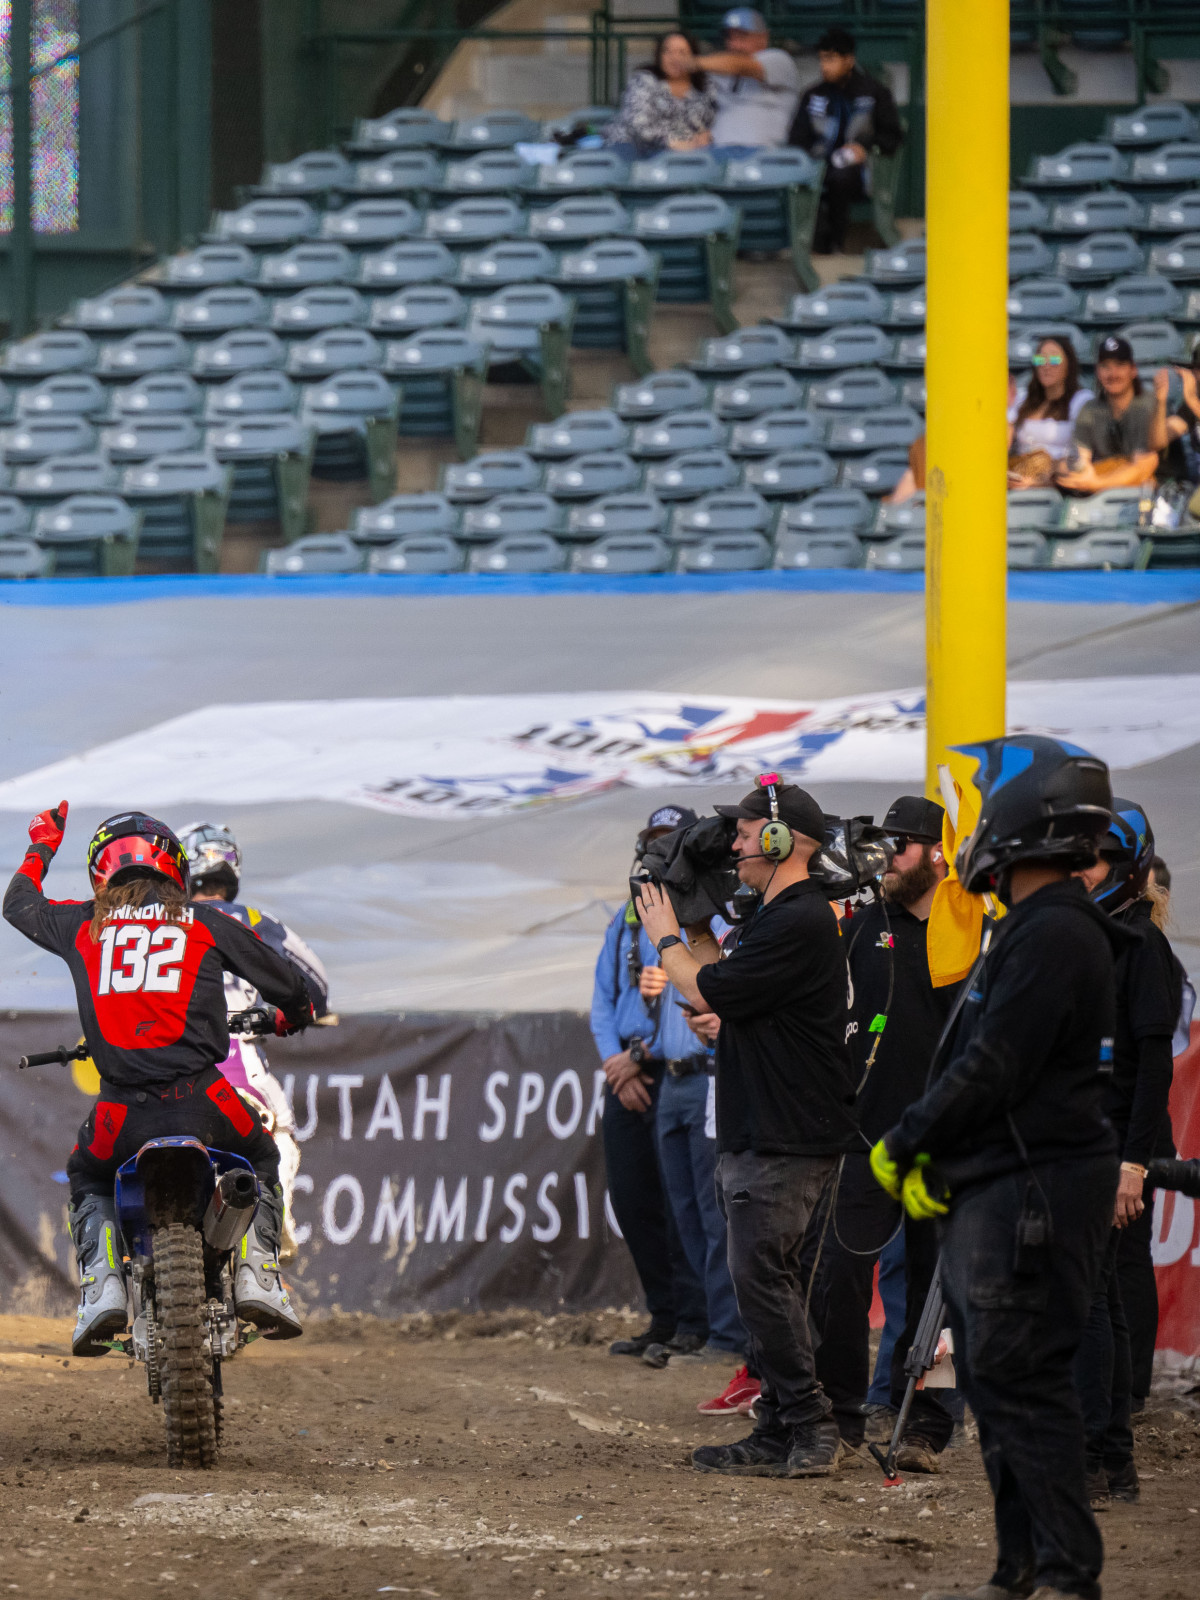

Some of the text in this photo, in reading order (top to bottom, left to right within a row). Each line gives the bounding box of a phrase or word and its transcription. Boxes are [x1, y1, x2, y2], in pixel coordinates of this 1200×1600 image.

[97, 923, 188, 996] 132
[282, 1073, 452, 1142] UTAH
[294, 1170, 624, 1246] COMMISSI
